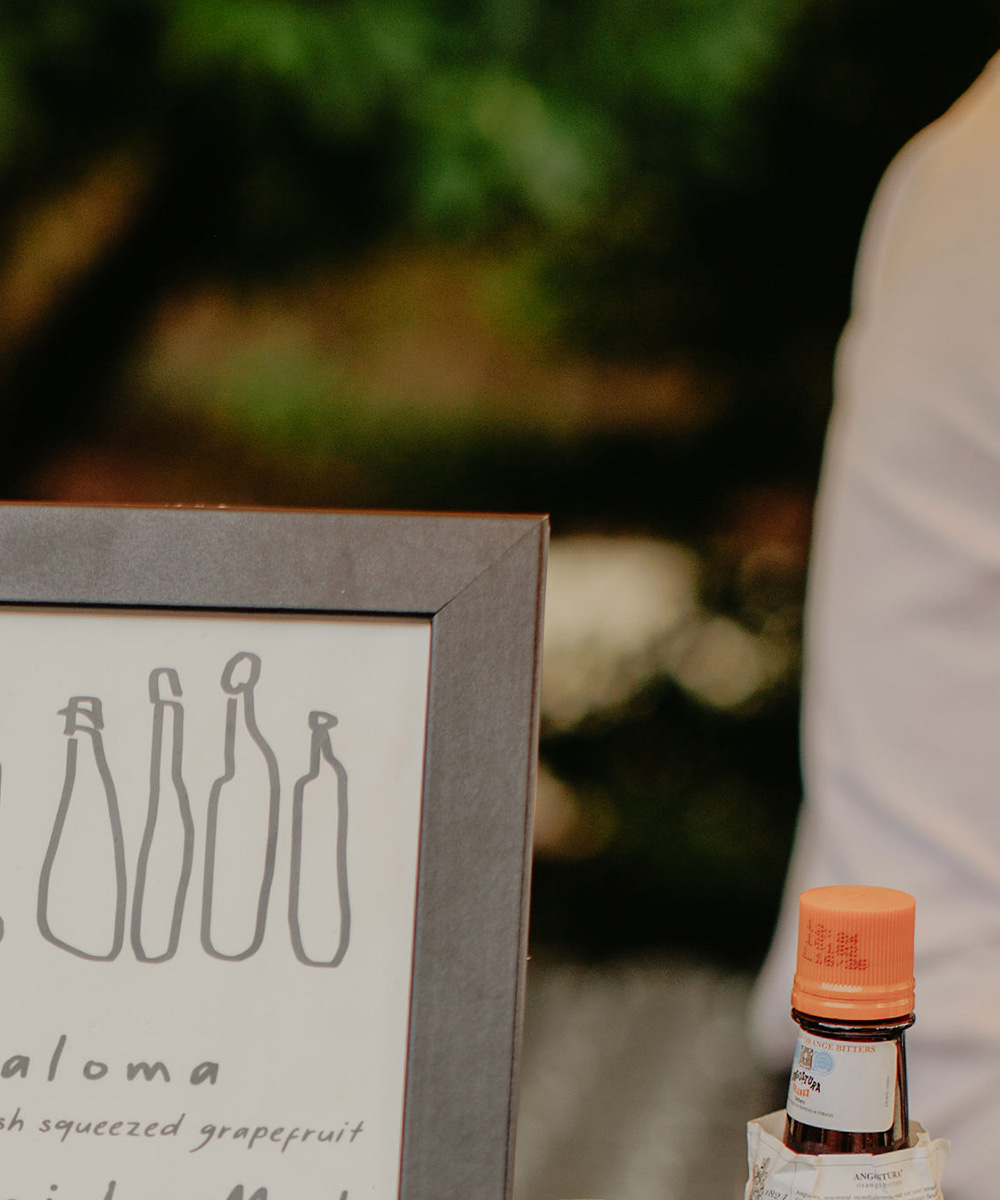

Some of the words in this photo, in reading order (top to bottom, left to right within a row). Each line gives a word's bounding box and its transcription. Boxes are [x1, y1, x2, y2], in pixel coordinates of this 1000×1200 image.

[803, 1037, 834, 1051] ORANGE
[836, 1044, 876, 1053] BITTERS
[38, 1112, 186, 1143] squeezed
[189, 1120, 364, 1153] grapefruit
